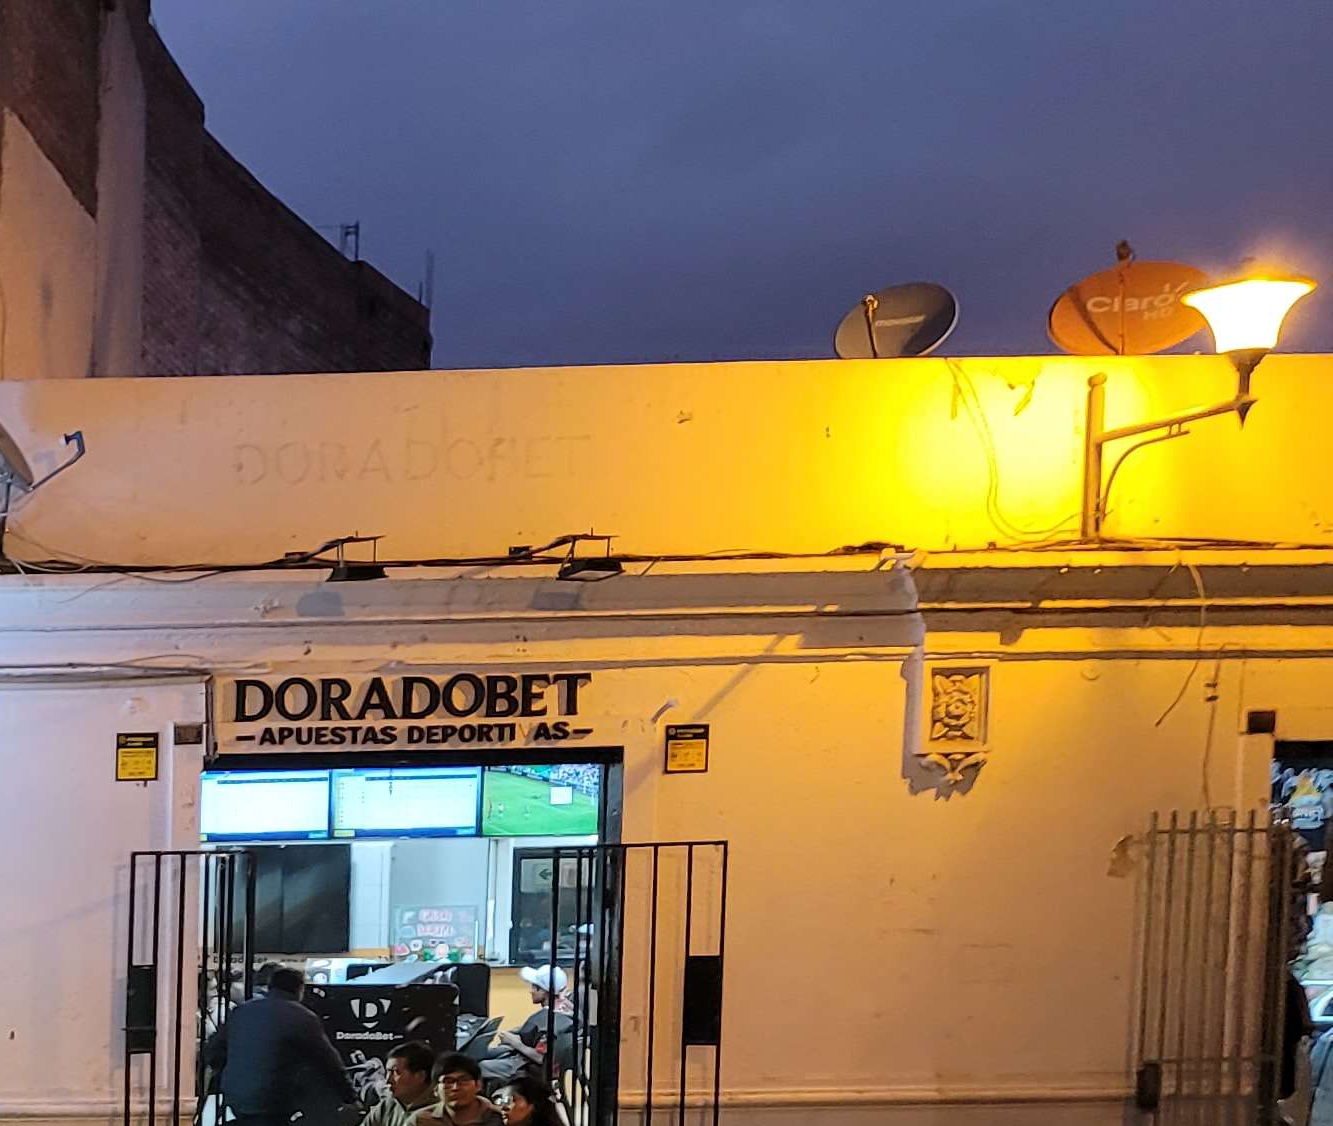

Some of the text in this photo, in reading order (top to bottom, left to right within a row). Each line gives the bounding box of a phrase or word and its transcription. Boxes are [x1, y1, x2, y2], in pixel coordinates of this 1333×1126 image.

[1087, 293, 1174, 312] Claro
[233, 673, 592, 722] DORADOBET
[259, 724, 398, 746] APUESTAS
